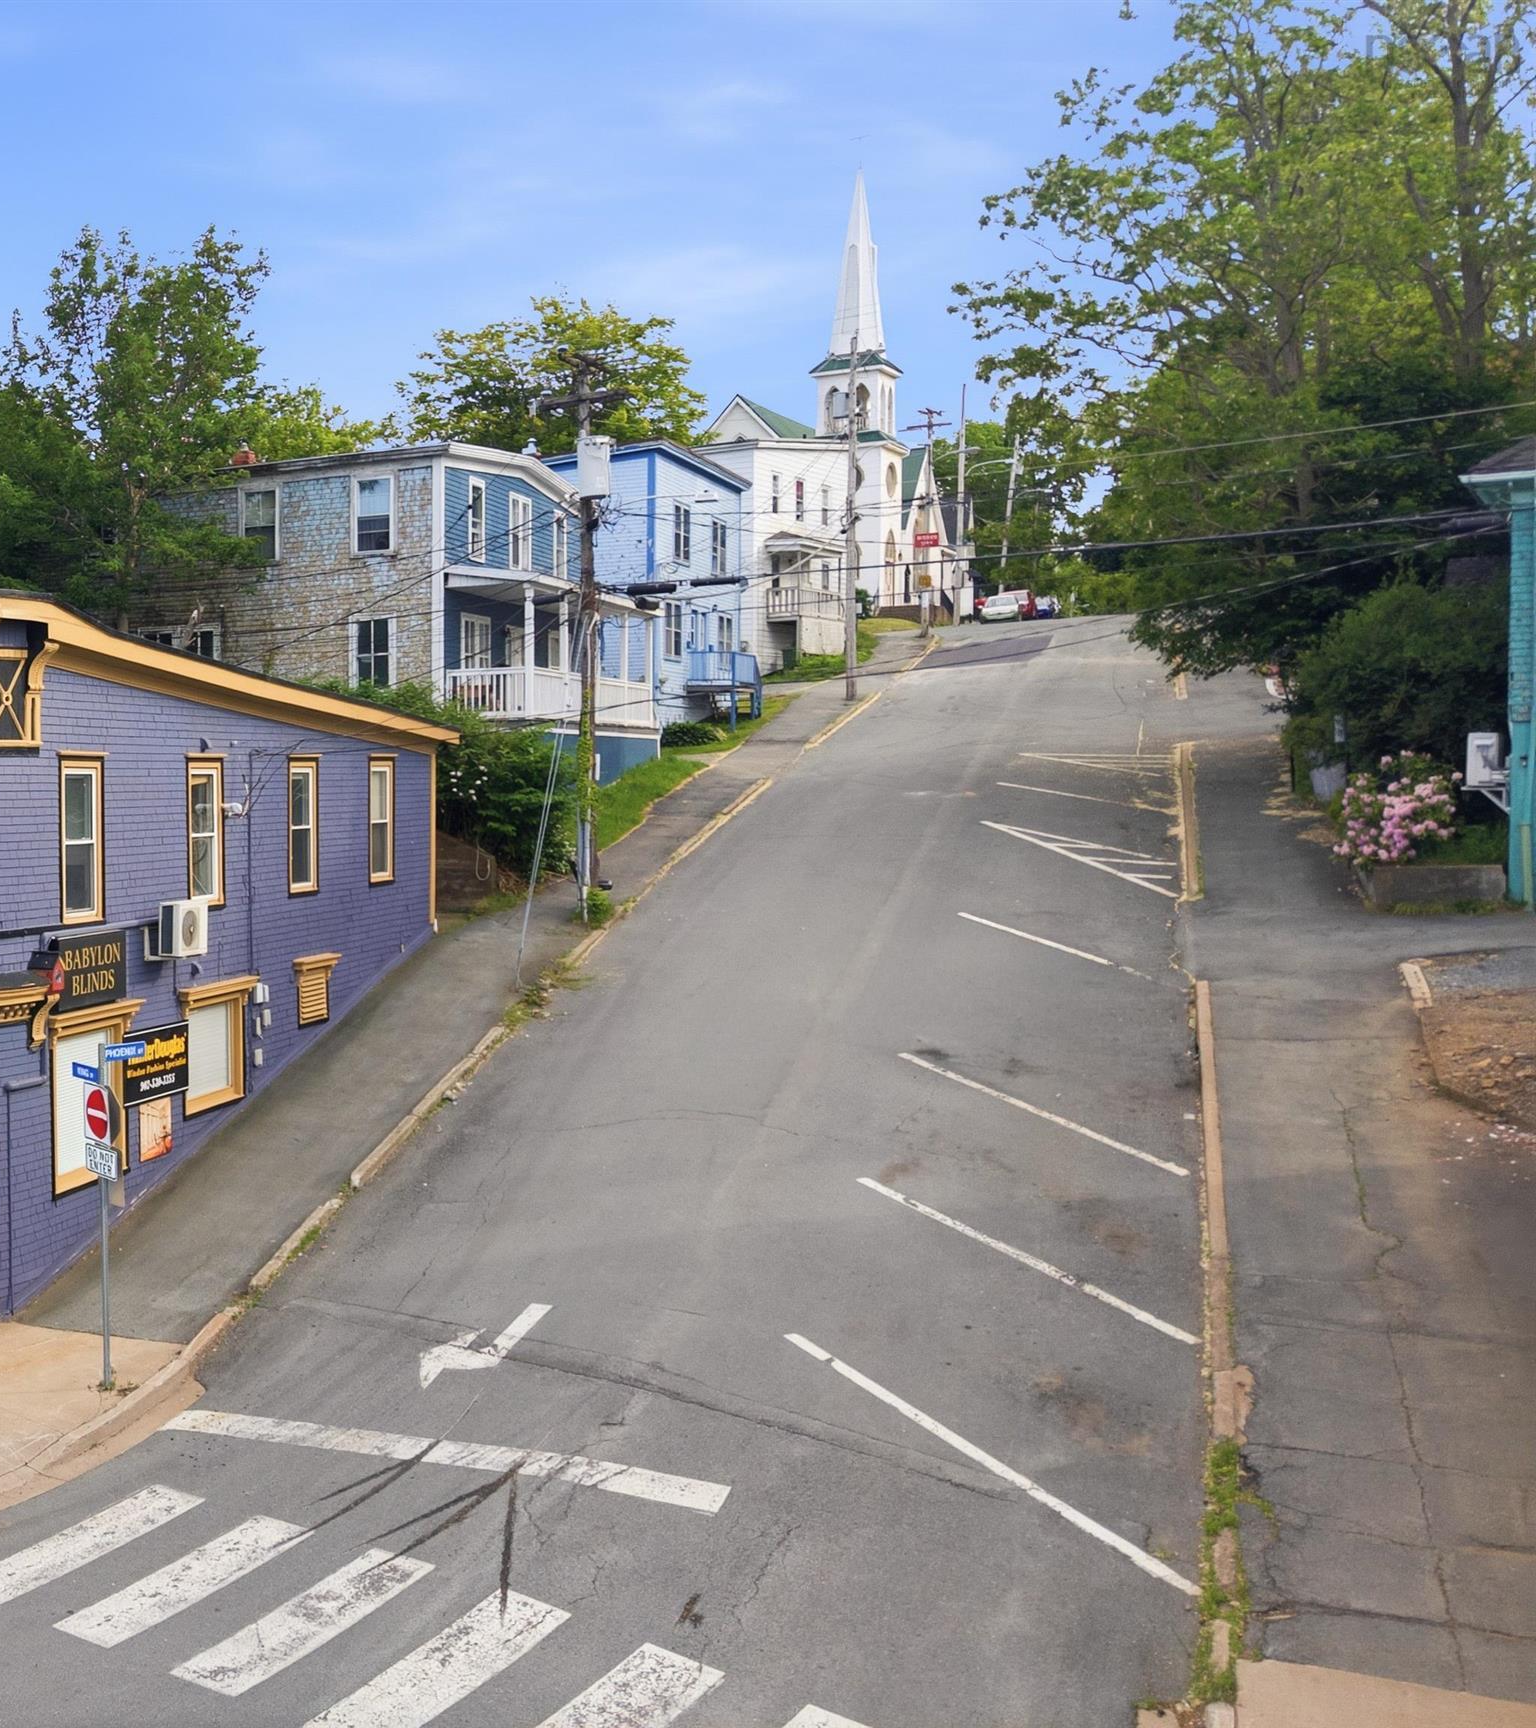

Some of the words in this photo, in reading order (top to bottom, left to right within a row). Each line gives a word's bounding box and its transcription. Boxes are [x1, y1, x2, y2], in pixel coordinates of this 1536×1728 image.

[65, 943, 121, 971] BABYLON
[72, 969, 115, 996] BLINDS
[105, 1045, 136, 1058] PHOENIX
[88, 1147, 98, 1159] DO
[100, 1151, 114, 1164] NOT
[89, 1159, 112, 1175] ENTER
